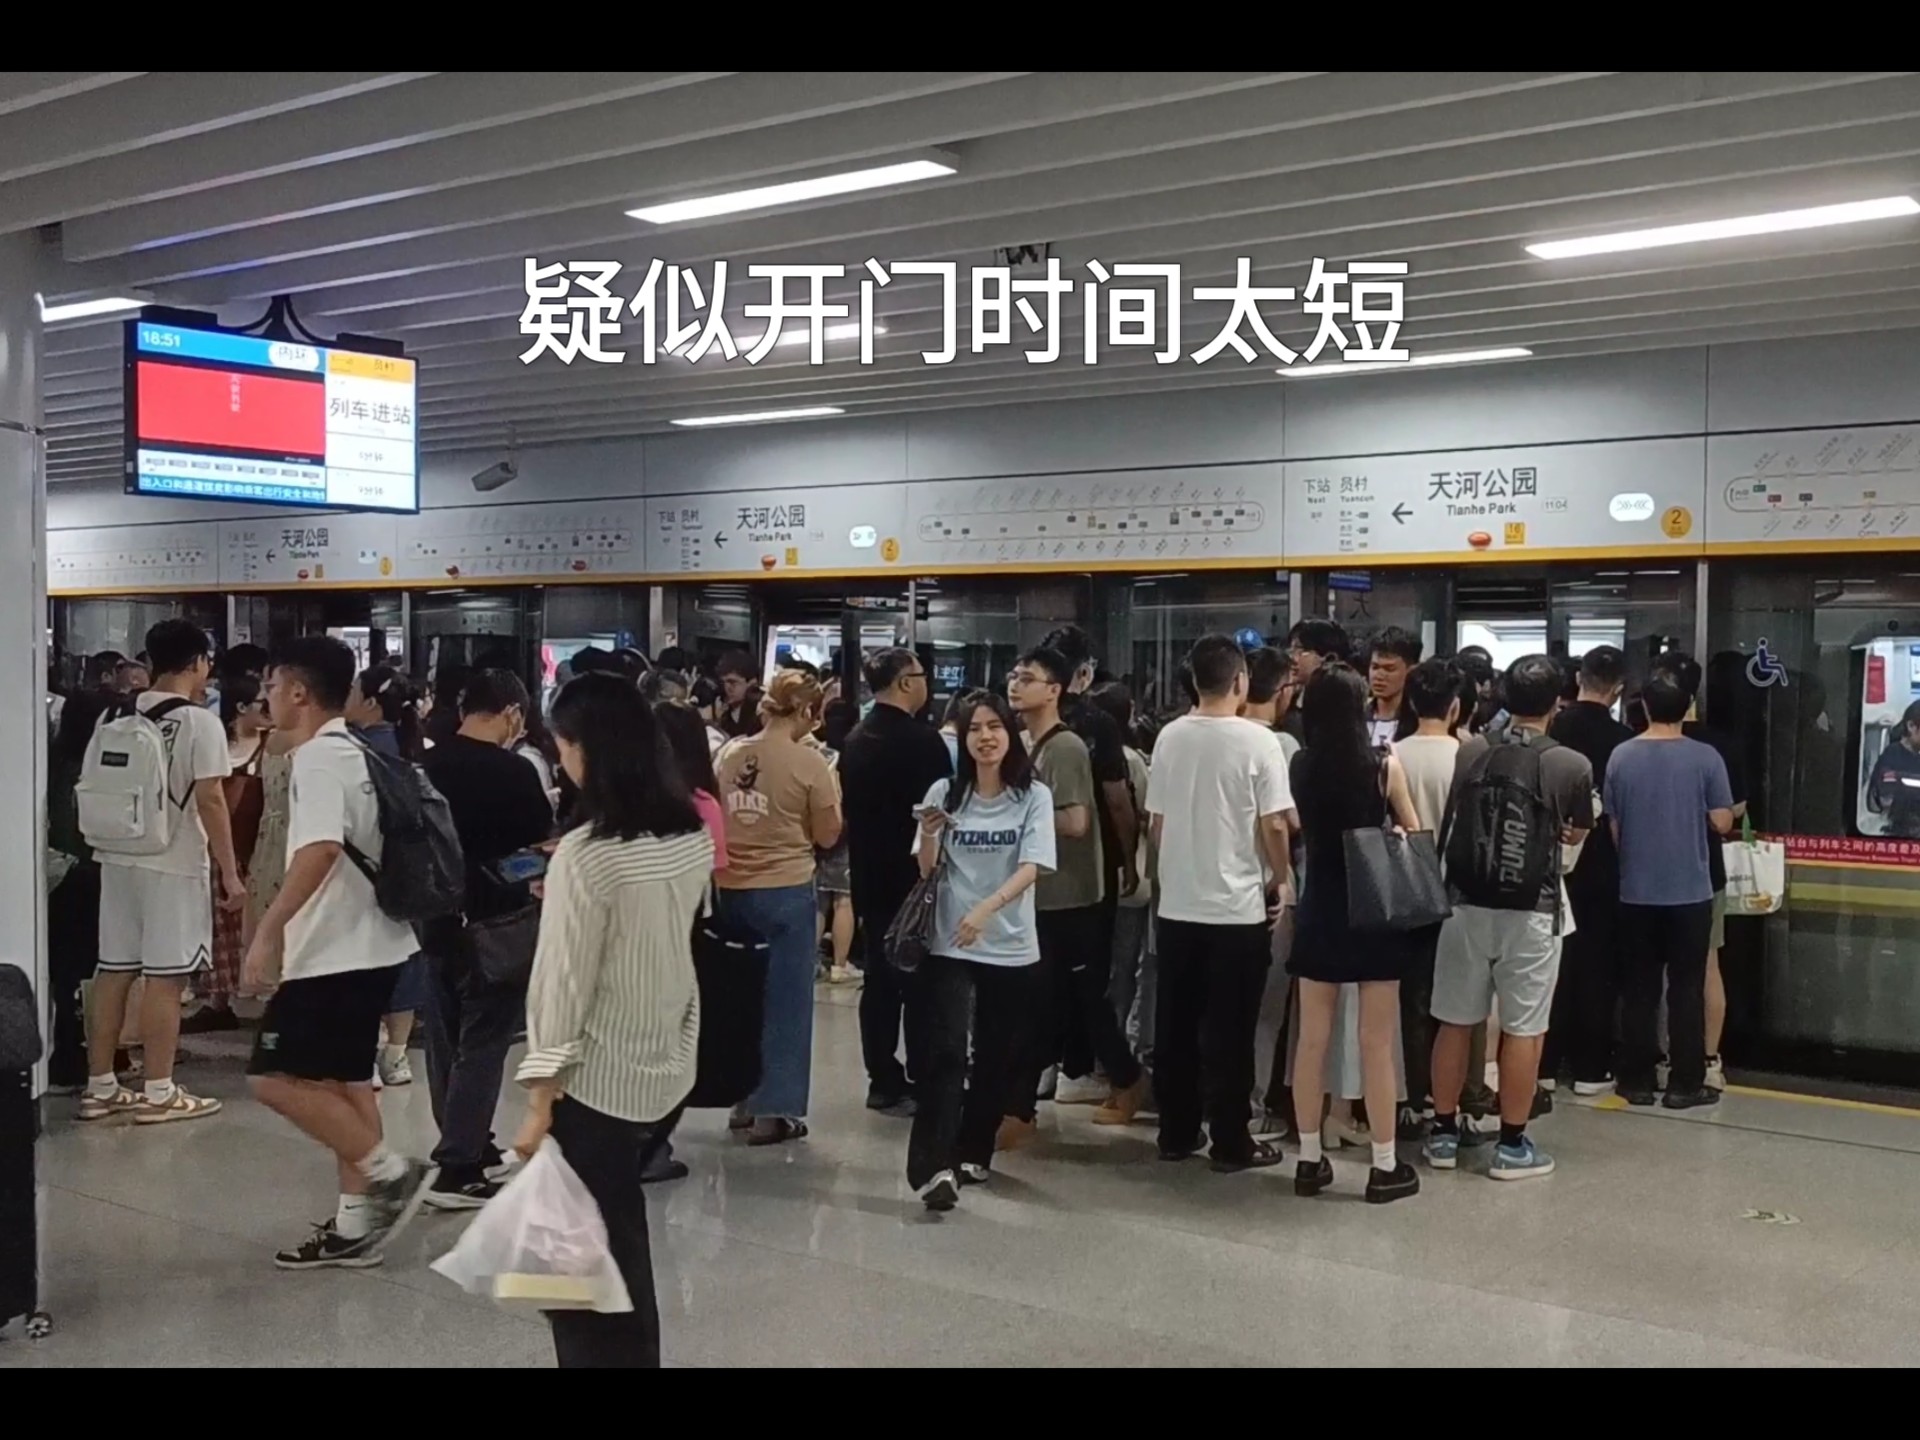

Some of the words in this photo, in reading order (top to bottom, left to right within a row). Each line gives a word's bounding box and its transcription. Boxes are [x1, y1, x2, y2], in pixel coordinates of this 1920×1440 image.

[142, 331, 181, 348] 18:51
[330, 398, 411, 425] 列车进站
[1303, 477, 1331, 494] 下站
[1340, 475, 1369, 493] 员村
[1427, 467, 1537, 501] 天河公园
[737, 504, 805, 530] 天河公园
[1446, 504, 1486, 516] Tianhe
[1488, 502, 1517, 514] Park
[1671, 508, 1683, 525] 2
[281, 528, 329, 549] 天河公园
[775, 532, 792, 541] Park
[727, 790, 770, 816] NIKE
[1500, 818, 1527, 884] PUMA
